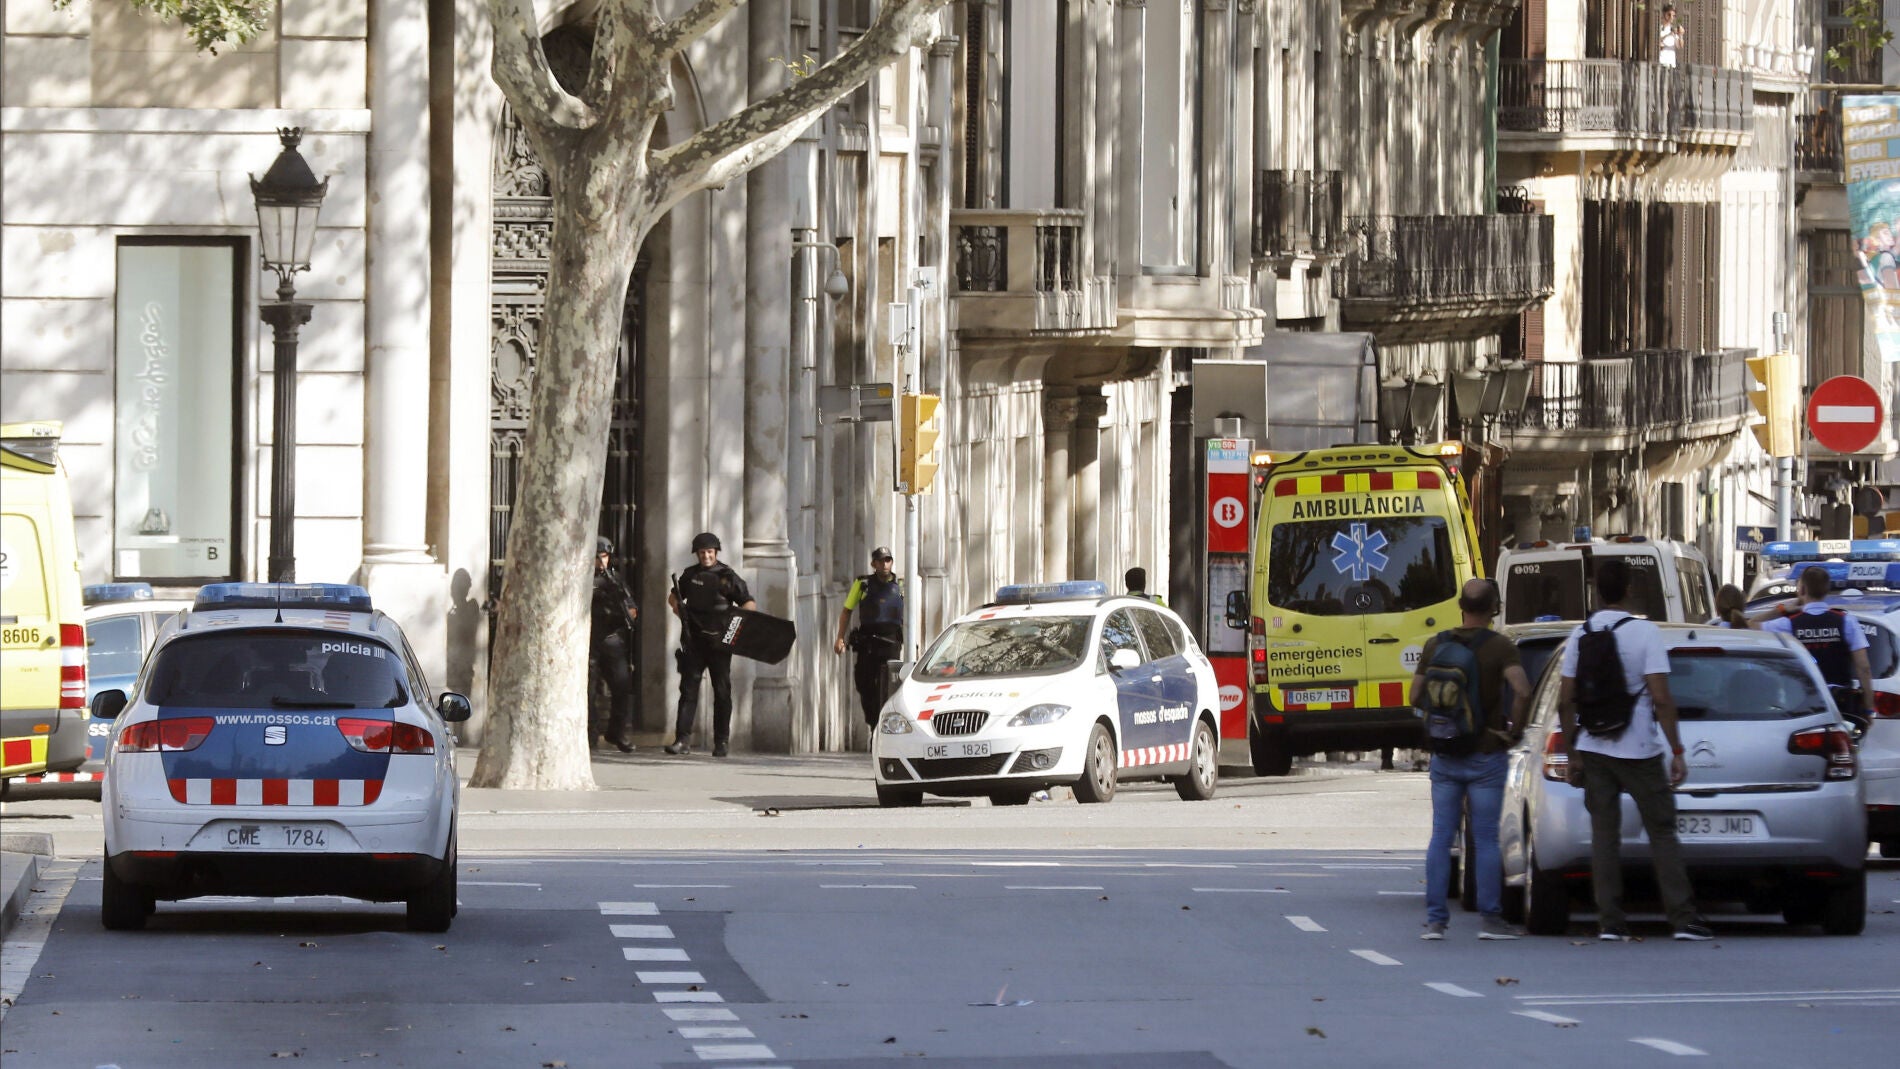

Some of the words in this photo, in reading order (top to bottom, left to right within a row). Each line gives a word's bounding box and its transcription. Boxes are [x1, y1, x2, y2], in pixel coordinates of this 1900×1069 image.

[1849, 143, 1882, 160] OUR
[1292, 494, 1425, 519] AMBULÀNCIA
[207, 546, 218, 560] B
[1522, 564, 1541, 574] 092
[1852, 566, 1884, 577] POLICIA
[3, 628, 40, 644] 8606
[1797, 627, 1841, 639] POLICIA
[321, 642, 371, 657] policia
[1270, 646, 1363, 663] emergències
[1271, 663, 1341, 680] mèdiques
[948, 691, 1003, 701] policia
[1295, 691, 1322, 703] 0867
[1326, 690, 1349, 701] HTR
[215, 713, 337, 727] www.mossos.cat
[1134, 710, 1157, 725] mossos
[1159, 704, 1189, 724] d'esquadra
[927, 745, 948, 757] CME
[962, 743, 989, 756] 1826
[1678, 817, 1711, 834] 823
[1719, 817, 1753, 834] JMD
[227, 828, 260, 846] CME
[285, 829, 326, 847] 1784
